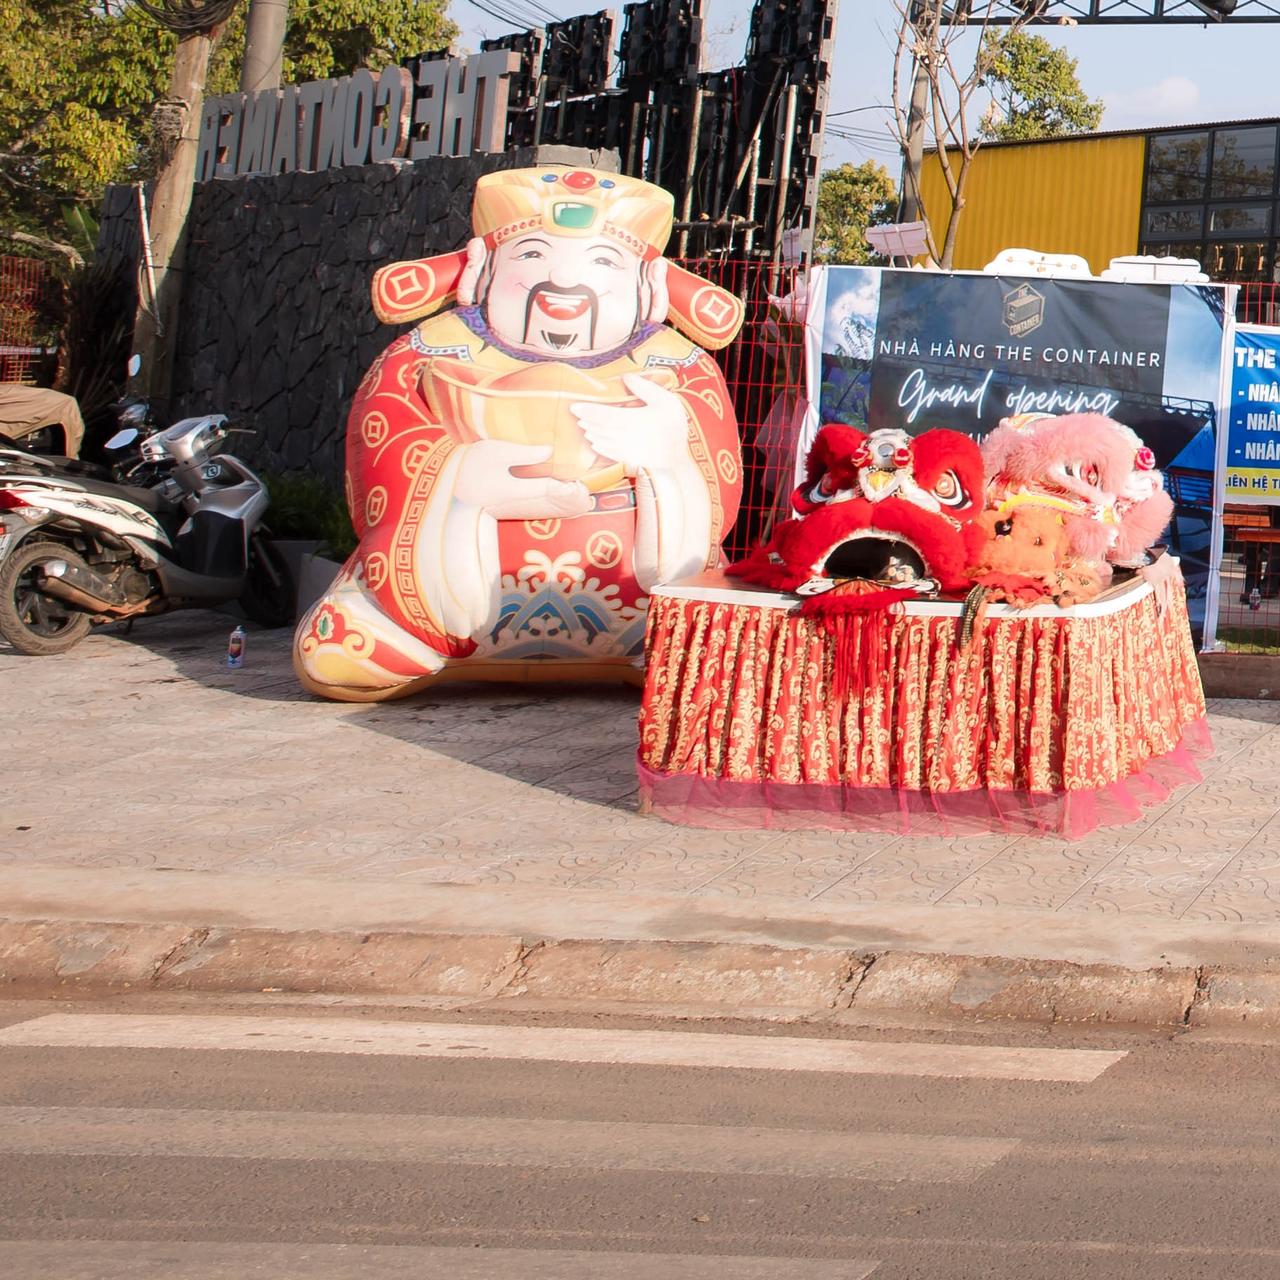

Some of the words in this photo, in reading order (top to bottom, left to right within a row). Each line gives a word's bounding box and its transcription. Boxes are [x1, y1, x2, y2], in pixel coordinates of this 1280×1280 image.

[879, 338, 920, 356] NHÀ
[930, 340, 986, 359] HÀNG
[995, 345, 1033, 361] THE
[1042, 347, 1161, 367] CONTAINER
[1234, 347, 1276, 369] THE
[898, 368, 994, 423] Grand
[1226, 473, 1248, 488] IÊN
[1252, 474, 1268, 492] HỆ
